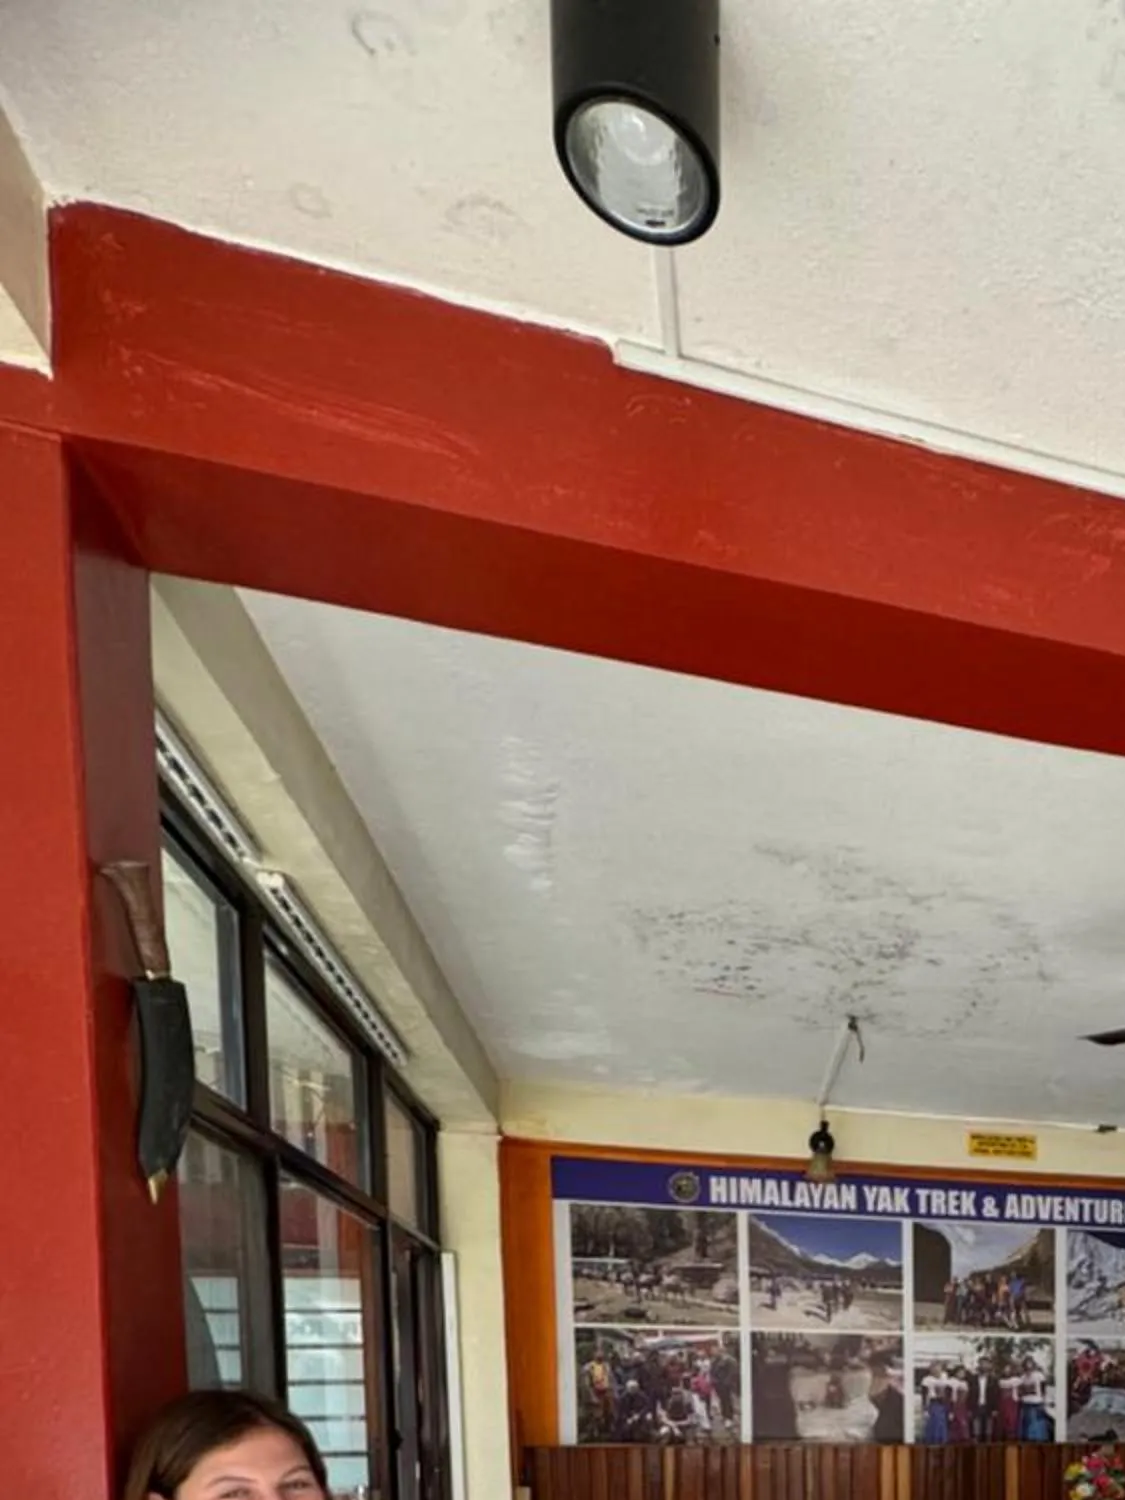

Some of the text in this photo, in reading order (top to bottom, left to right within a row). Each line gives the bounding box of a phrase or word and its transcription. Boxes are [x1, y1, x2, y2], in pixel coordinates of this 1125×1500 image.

[708, 1175, 858, 1212] HIMALAYAN
[863, 1184, 911, 1214] YAK
[915, 1187, 978, 1217] TREK
[981, 1195, 1001, 1219] &
